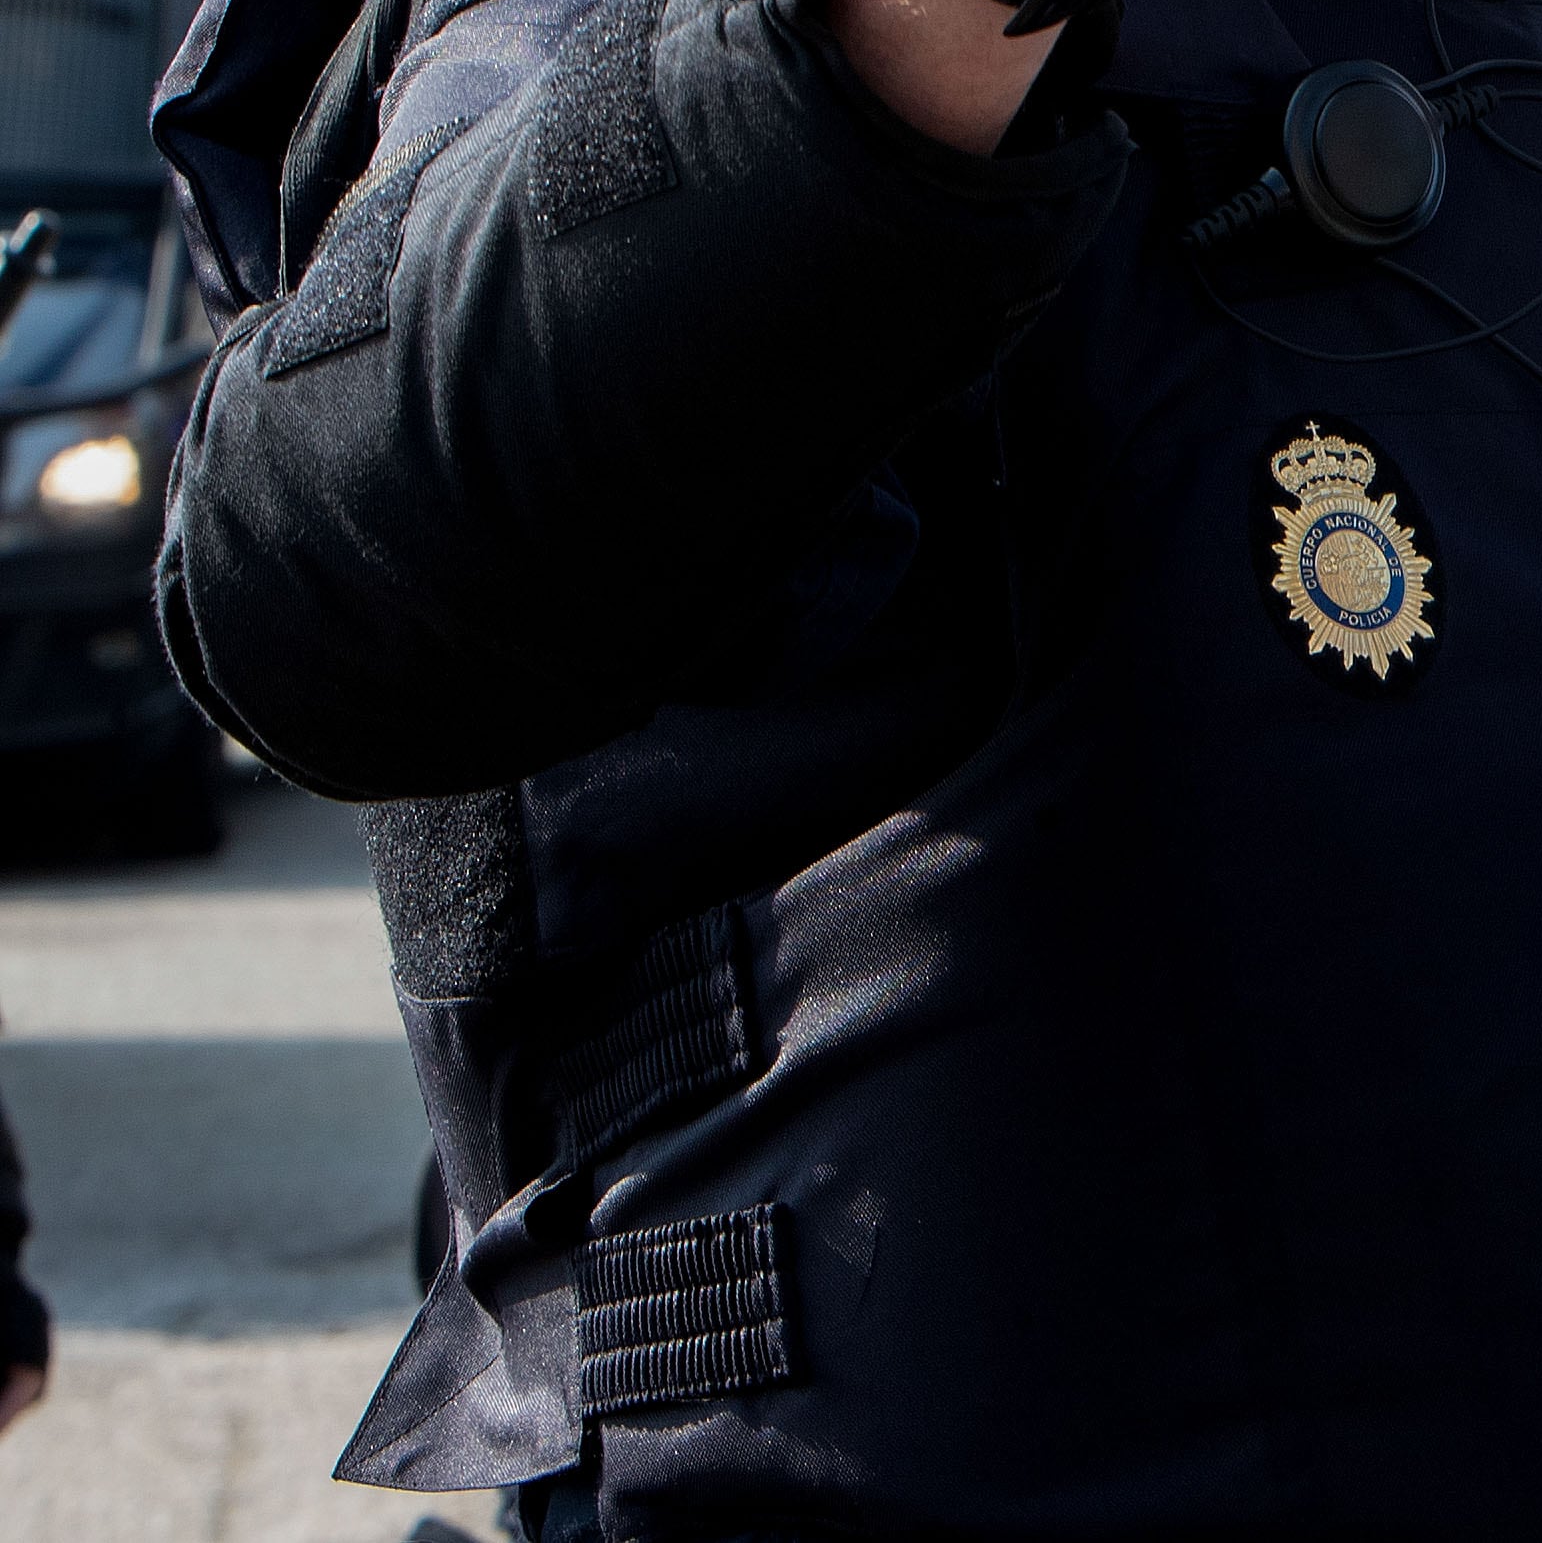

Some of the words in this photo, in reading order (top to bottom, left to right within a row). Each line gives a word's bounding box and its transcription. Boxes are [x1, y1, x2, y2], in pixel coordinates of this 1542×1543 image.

[1301, 528, 1323, 589] CUERPO
[1325, 514, 1388, 553] NACIONAL
[1388, 555, 1402, 579] DE
[1338, 607, 1393, 628] POLICIA
